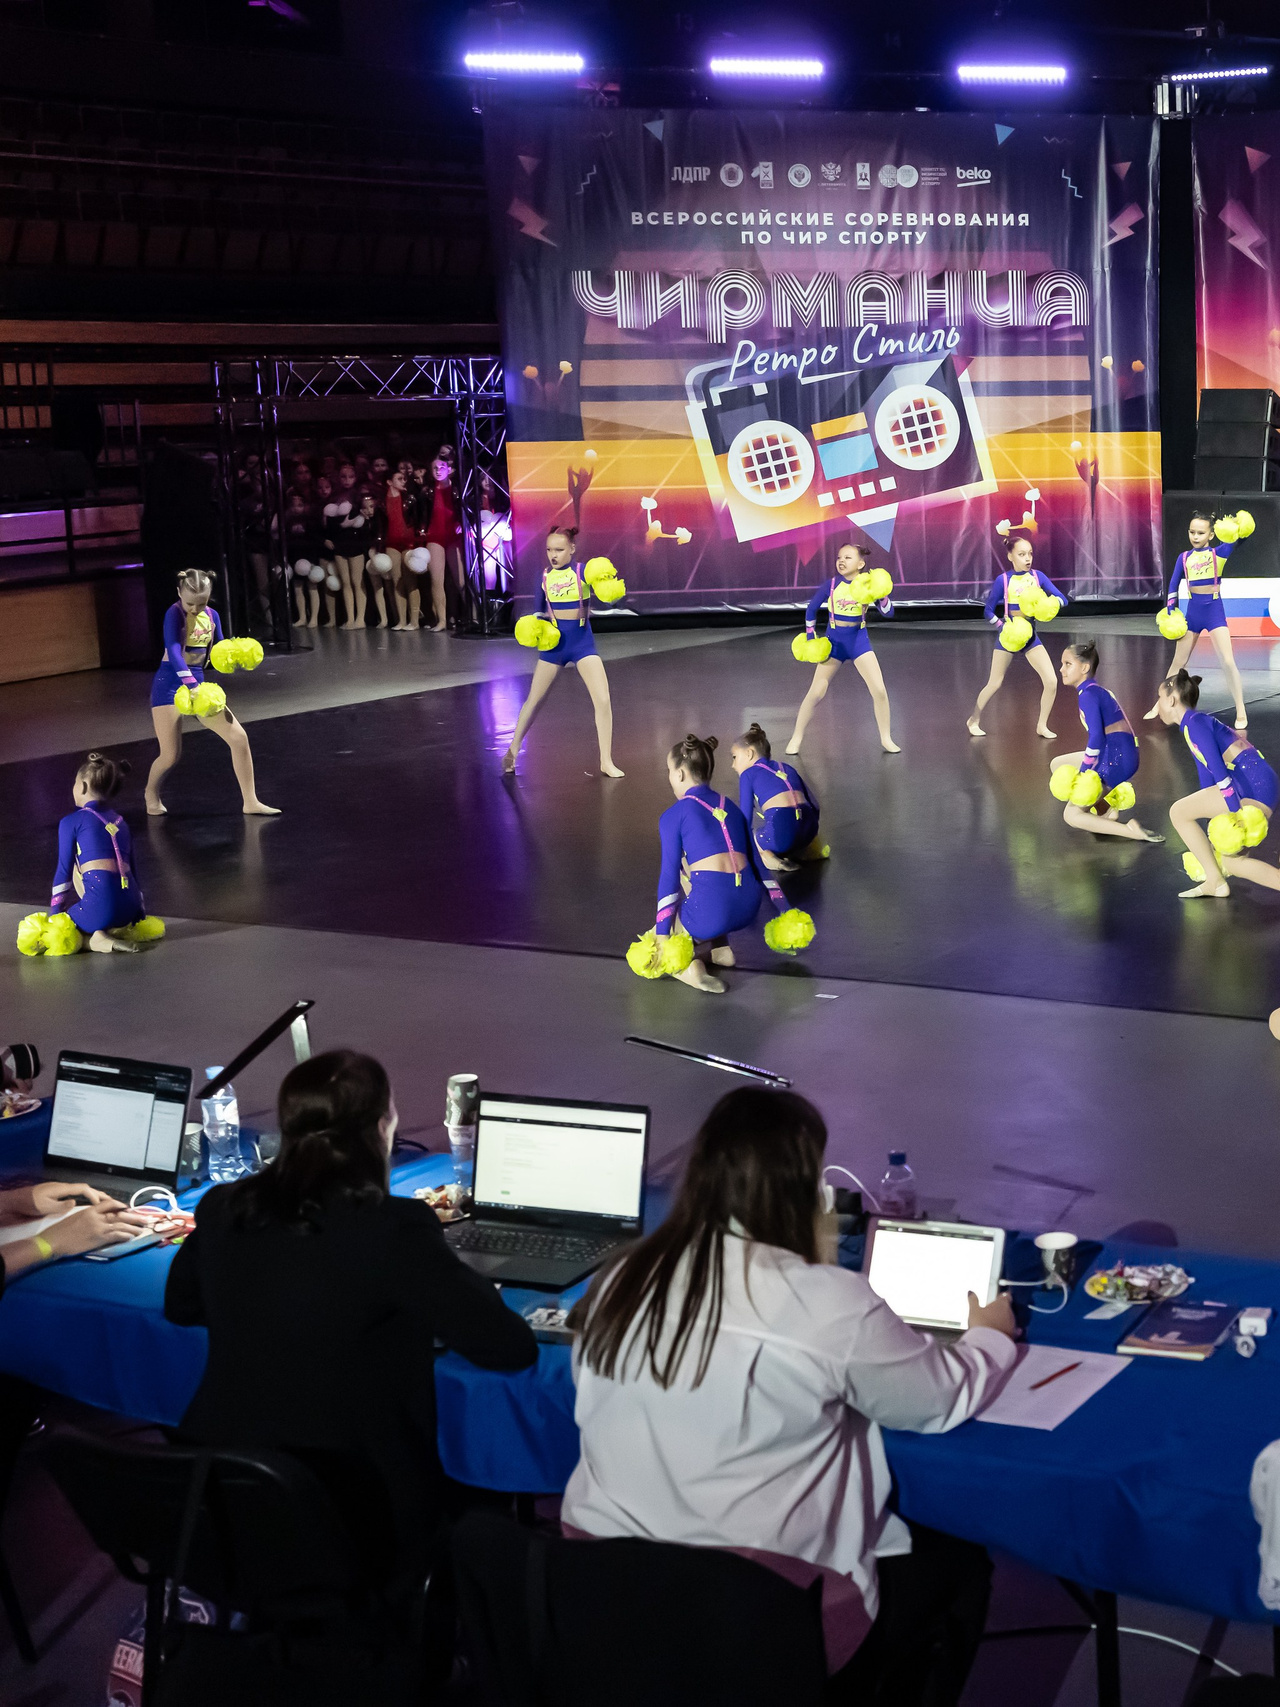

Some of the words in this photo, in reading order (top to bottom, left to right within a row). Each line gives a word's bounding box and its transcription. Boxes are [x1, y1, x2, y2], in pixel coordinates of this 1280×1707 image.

[671, 166, 711, 184] ЛДПР
[956, 166, 992, 180] beko
[631, 209, 835, 226] ВСЕРОССИЙСКИЕ
[844, 211, 1030, 226] СОРЕВНОВАНИЯ
[740, 230, 772, 245] ПО
[782, 230, 828, 245] ЧИР
[838, 229, 928, 246] СПОРТУ
[729, 339, 839, 382] Ретро
[852, 322, 961, 364] Стиль
